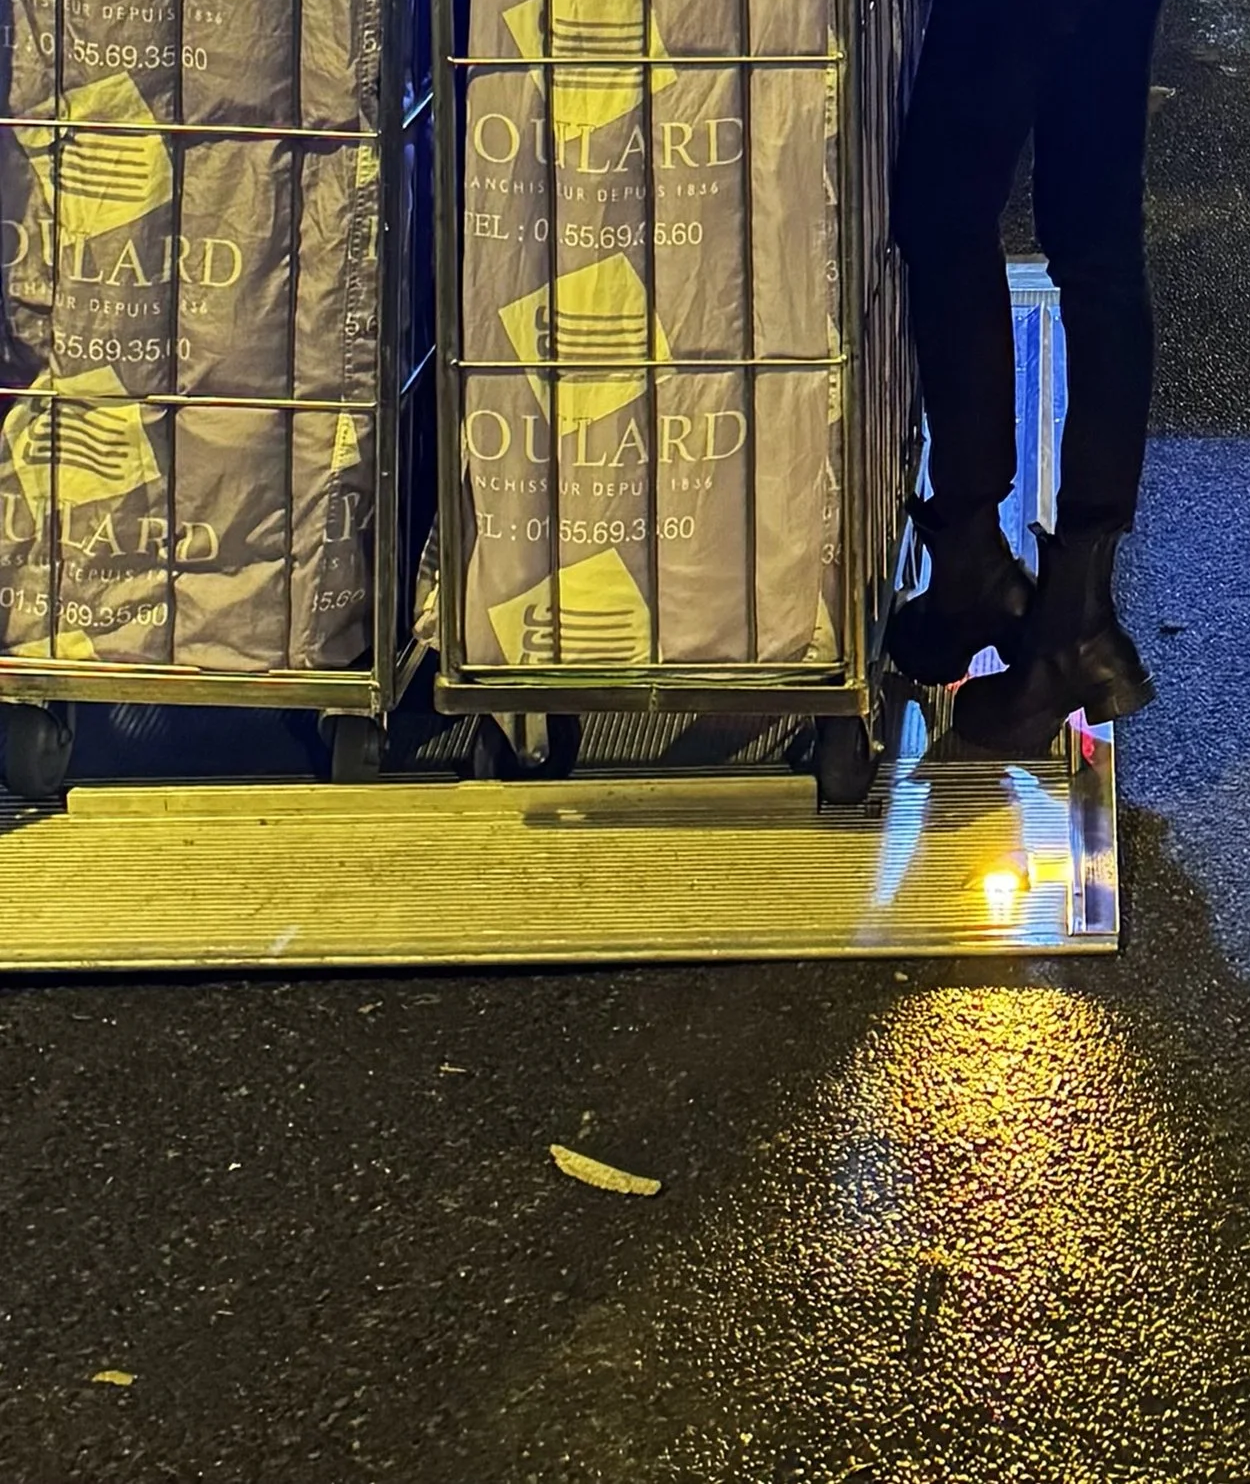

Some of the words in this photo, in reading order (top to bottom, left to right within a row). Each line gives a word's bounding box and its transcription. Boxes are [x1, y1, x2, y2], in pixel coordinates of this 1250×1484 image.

[102, 6, 176, 22] DEPUIS
[473, 113, 744, 174] OULARD
[598, 184, 666, 204] DEPUS
[89, 298, 162, 317] DEPUIS
[475, 475, 581, 496] NCHISSUR
